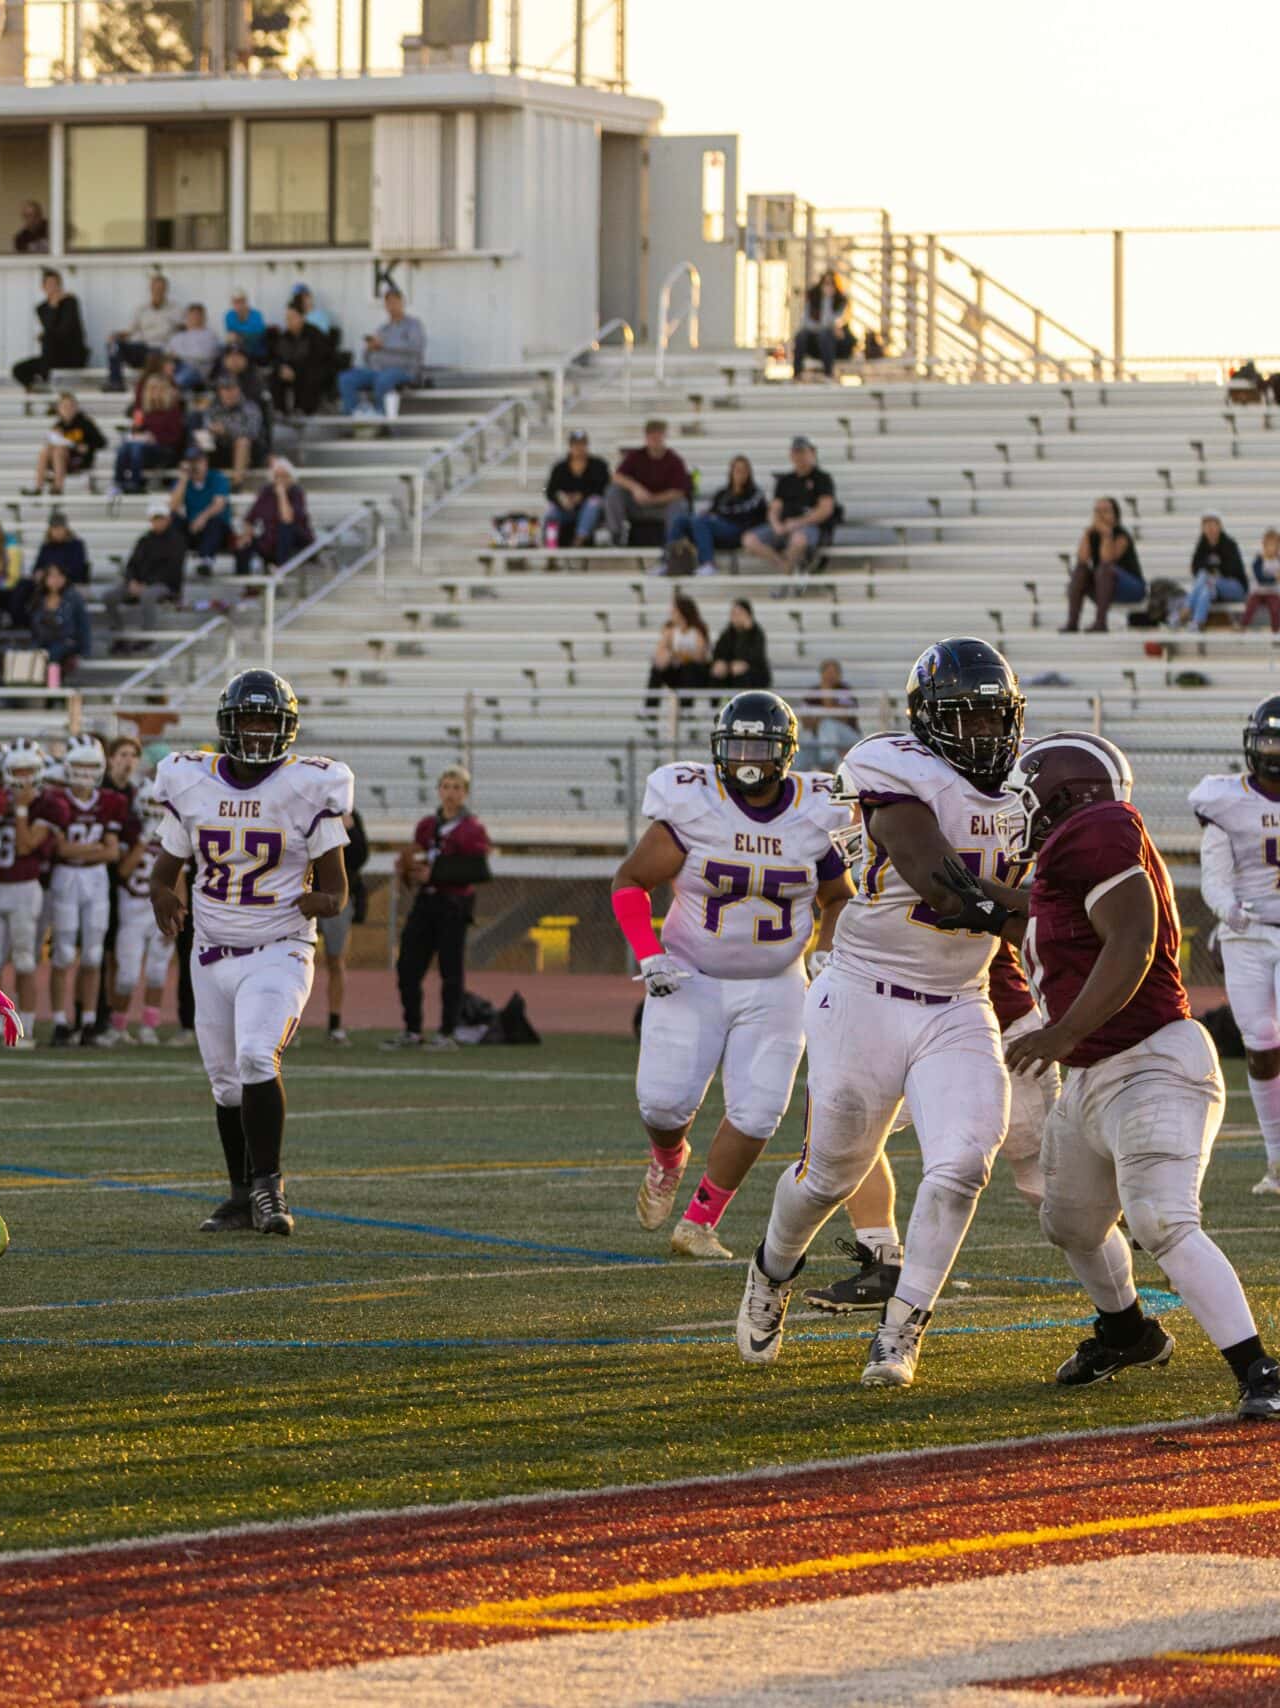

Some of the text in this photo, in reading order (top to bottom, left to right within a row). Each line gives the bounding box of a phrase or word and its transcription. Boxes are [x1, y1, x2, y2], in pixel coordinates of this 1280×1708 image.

[373, 257, 402, 299] K
[219, 800, 262, 819] ELITE
[734, 832, 783, 857] ELITE
[196, 825, 287, 907] 62
[702, 857, 812, 945] 75
